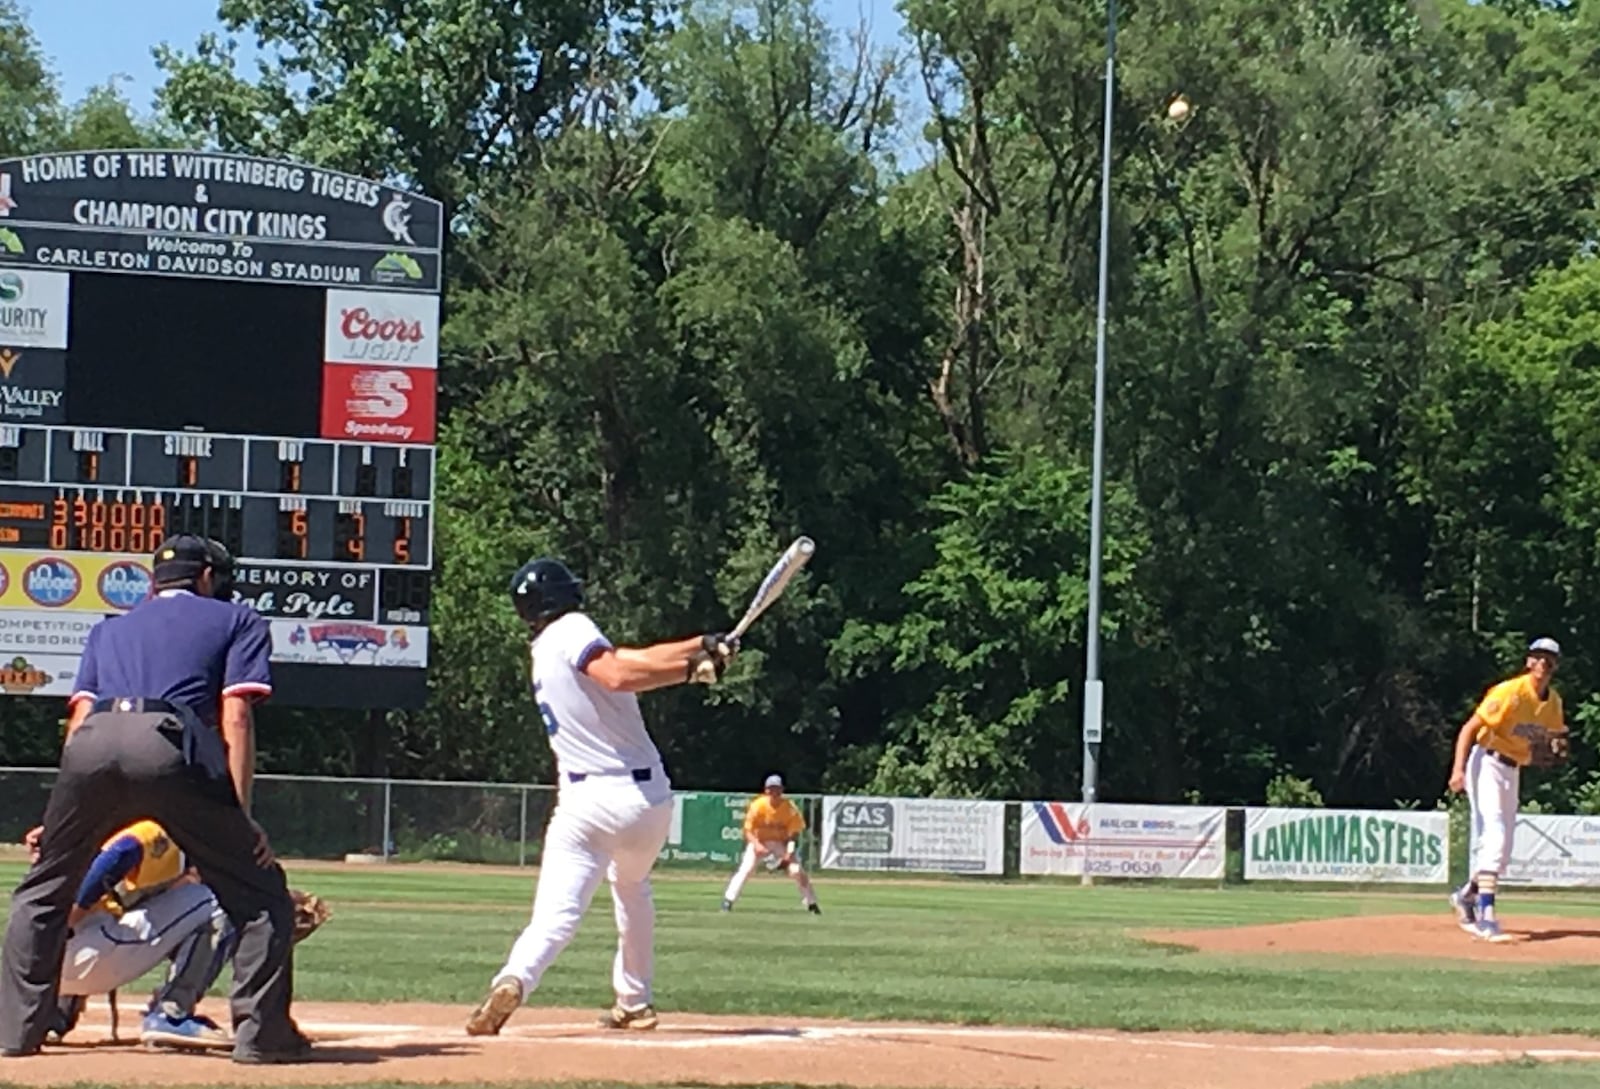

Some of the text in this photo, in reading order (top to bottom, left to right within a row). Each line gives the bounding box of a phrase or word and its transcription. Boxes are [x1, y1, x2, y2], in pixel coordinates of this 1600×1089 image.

[22, 154, 380, 207] HOME OF THE WITTENBERG TIGERS
[195, 183, 209, 203] &
[74, 200, 326, 240] CHAMPION CITY KINGS
[147, 236, 254, 257] Welcome To
[37, 247, 149, 269] CARLETON
[157, 255, 263, 276] DAVIDSON
[270, 263, 361, 282] STADIUM
[341, 307, 424, 342] Coors
[343, 341, 419, 362] LIGHT
[344, 420, 414, 440] Speedway
[73, 431, 104, 451] BALL
[165, 435, 212, 457] STRIKE
[279, 439, 304, 462] OUT
[341, 572, 371, 588] OF
[282, 592, 356, 620] Pyle
[842, 806, 886, 825] SAS
[1252, 815, 1441, 866] LAWNMASTERS
[1258, 864, 1297, 874] LAWN
